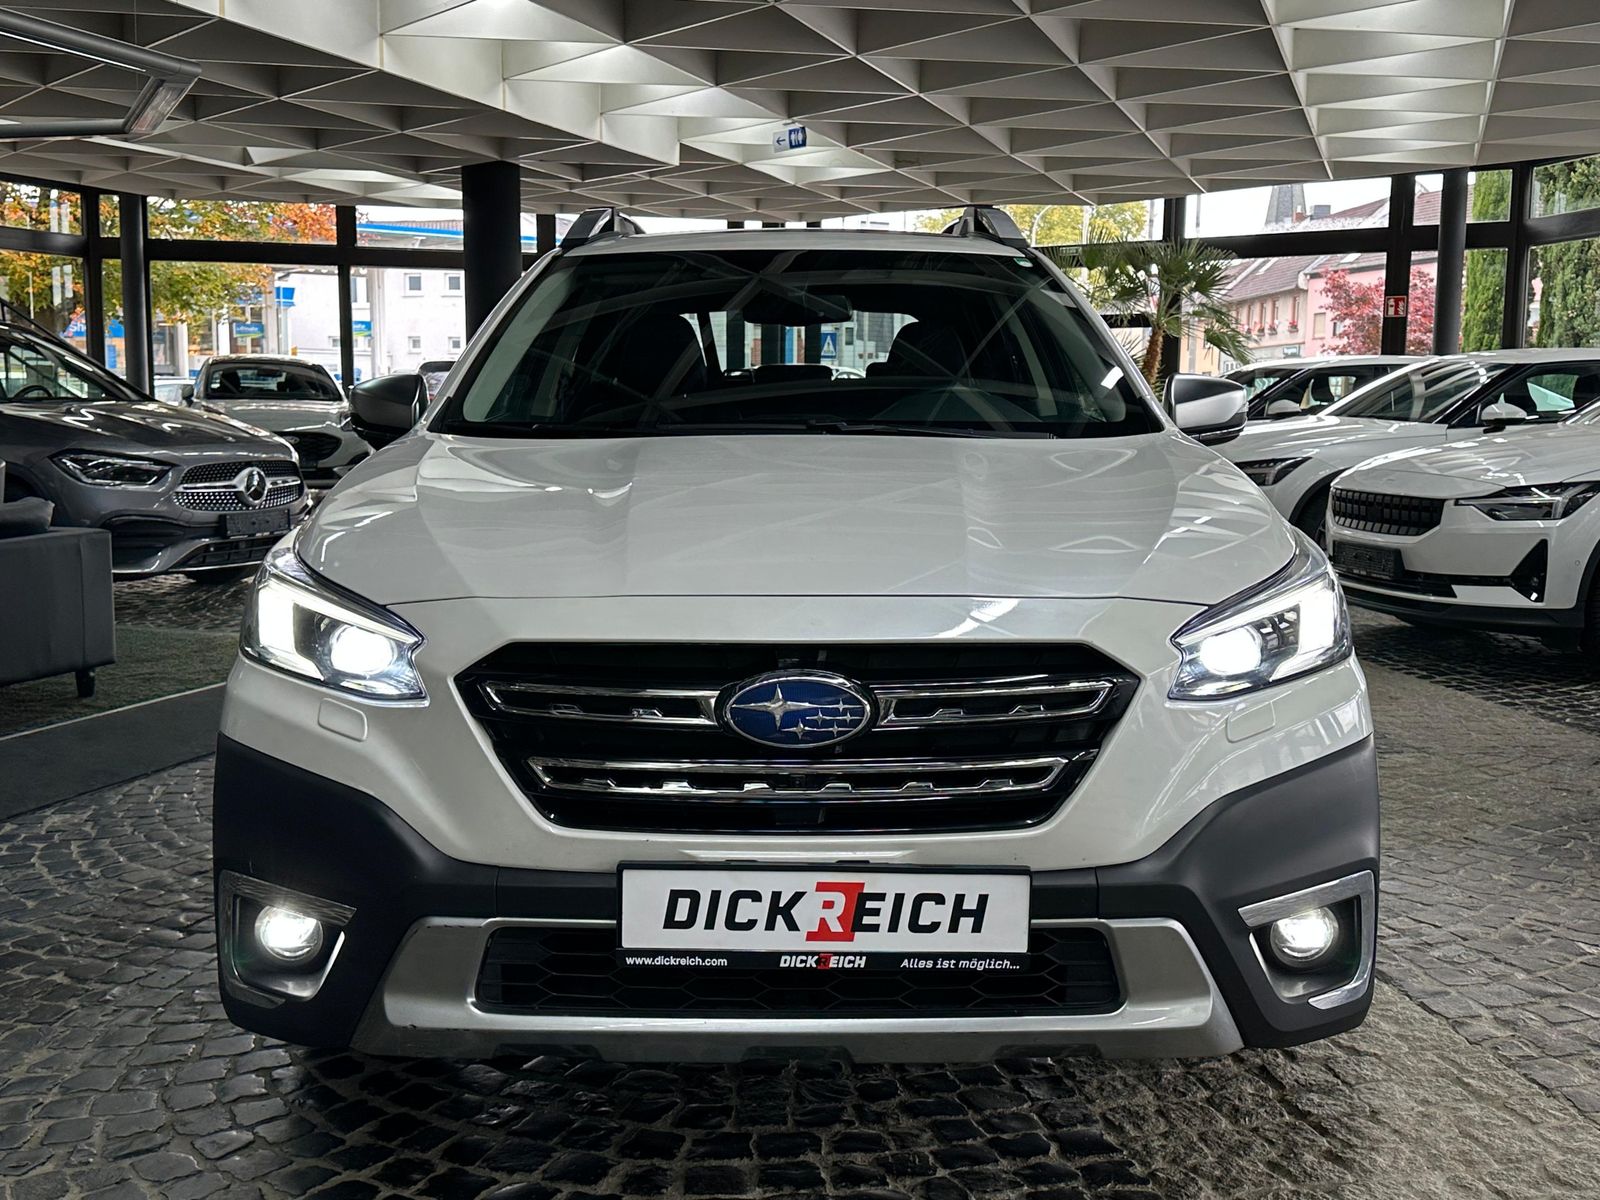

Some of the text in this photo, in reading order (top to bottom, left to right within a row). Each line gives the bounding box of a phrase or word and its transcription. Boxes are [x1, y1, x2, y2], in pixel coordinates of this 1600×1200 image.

[662, 881, 990, 942] DICKREICH
[625, 955, 728, 966] www.dickreich.com
[779, 953, 867, 970] DICKREICH
[900, 958, 1020, 971] Alles ist möglich...
